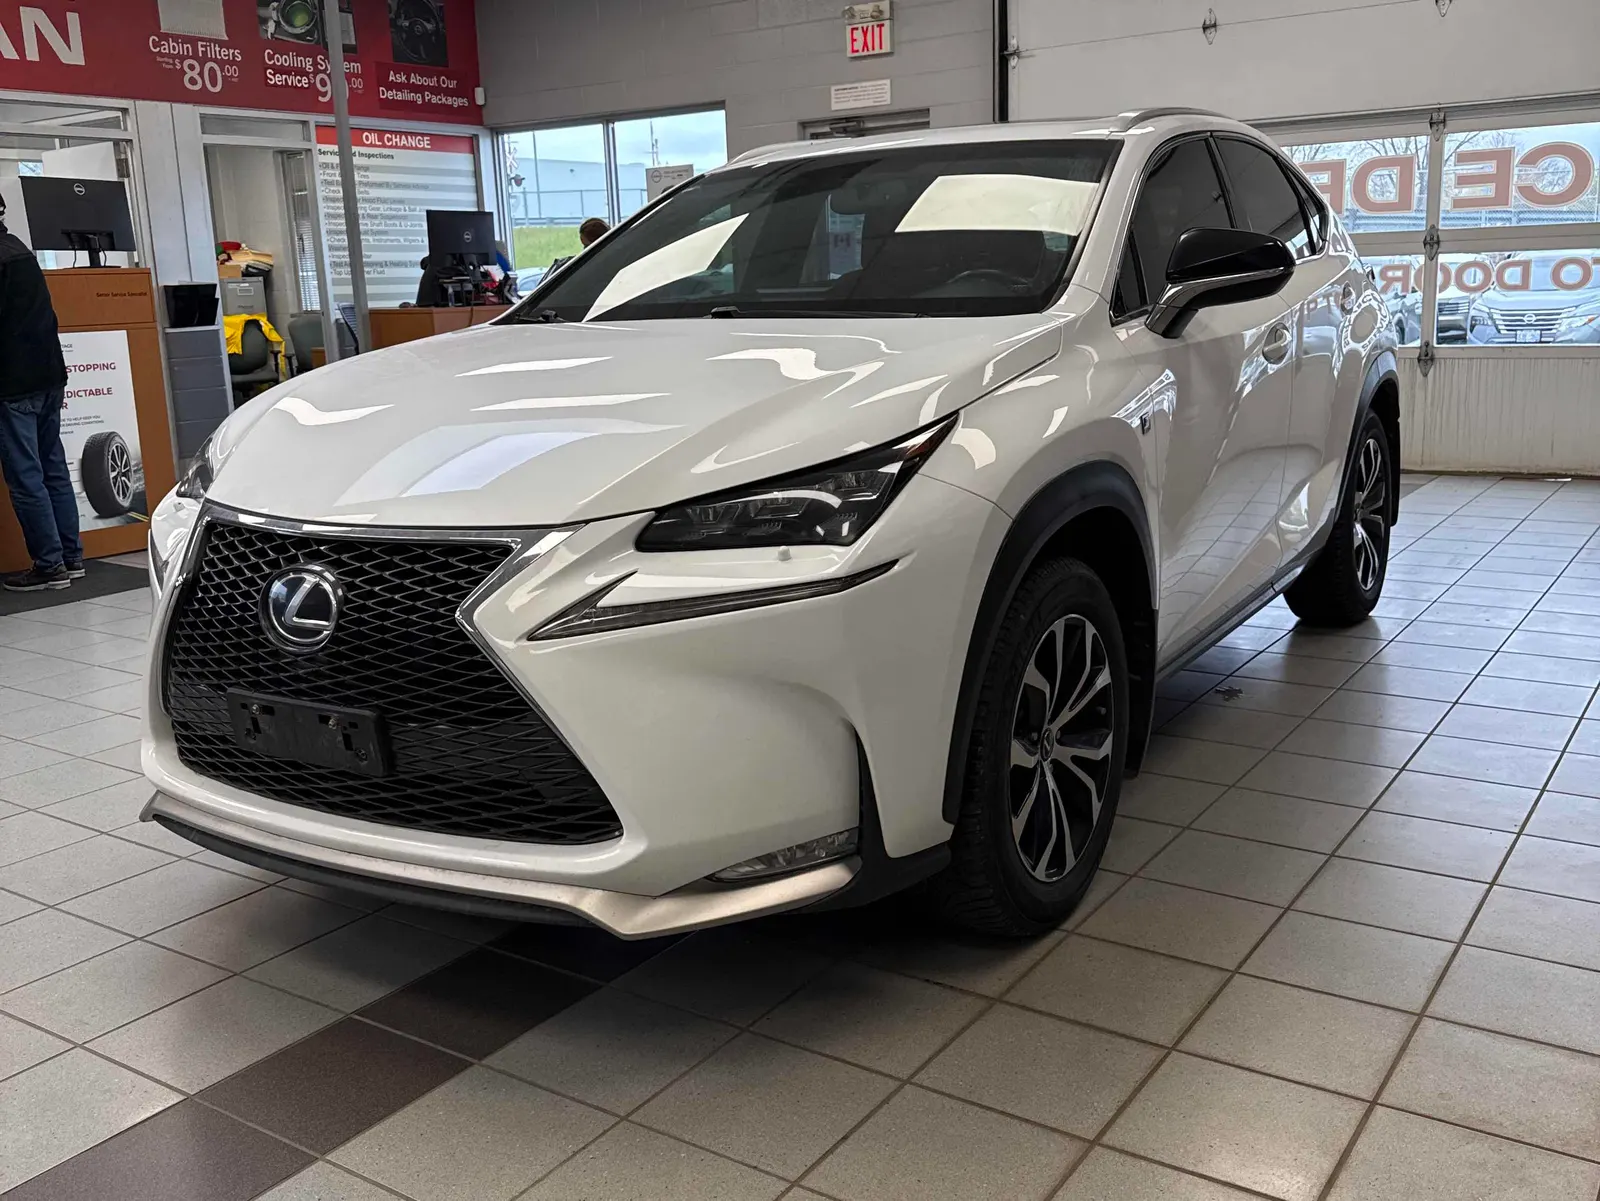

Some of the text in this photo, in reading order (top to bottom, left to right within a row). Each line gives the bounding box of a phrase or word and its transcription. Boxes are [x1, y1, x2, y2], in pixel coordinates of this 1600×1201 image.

[149, 35, 242, 61] Cabin Filters
[850, 23, 885, 54] EXIT
[264, 49, 362, 74] Cooling Syem
[266, 69, 309, 88] Service
[388, 70, 458, 88] Ask About Our
[379, 86, 469, 108] Detailing Packages
[362, 131, 432, 149] OIL CHANGE
[318, 148, 340, 157] Servic
[358, 150, 395, 160] Inspections
